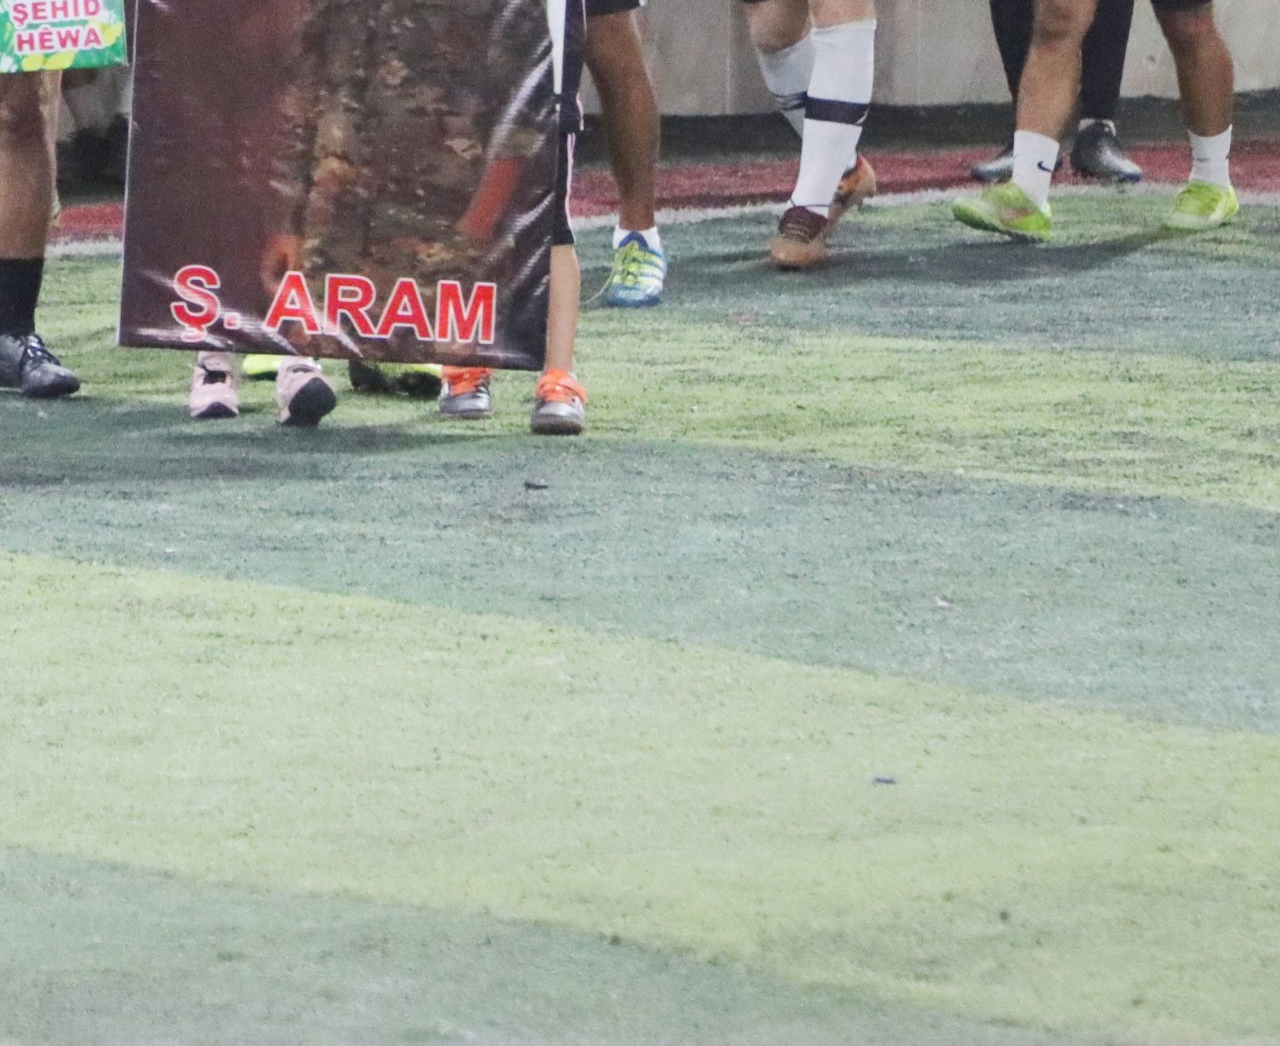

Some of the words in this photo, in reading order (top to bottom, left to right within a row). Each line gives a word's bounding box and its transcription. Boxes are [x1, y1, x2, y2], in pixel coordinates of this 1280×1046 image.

[16, 26, 102, 52] HÊWA
[170, 265, 240, 342] Ş.
[263, 270, 498, 344] ARAM
